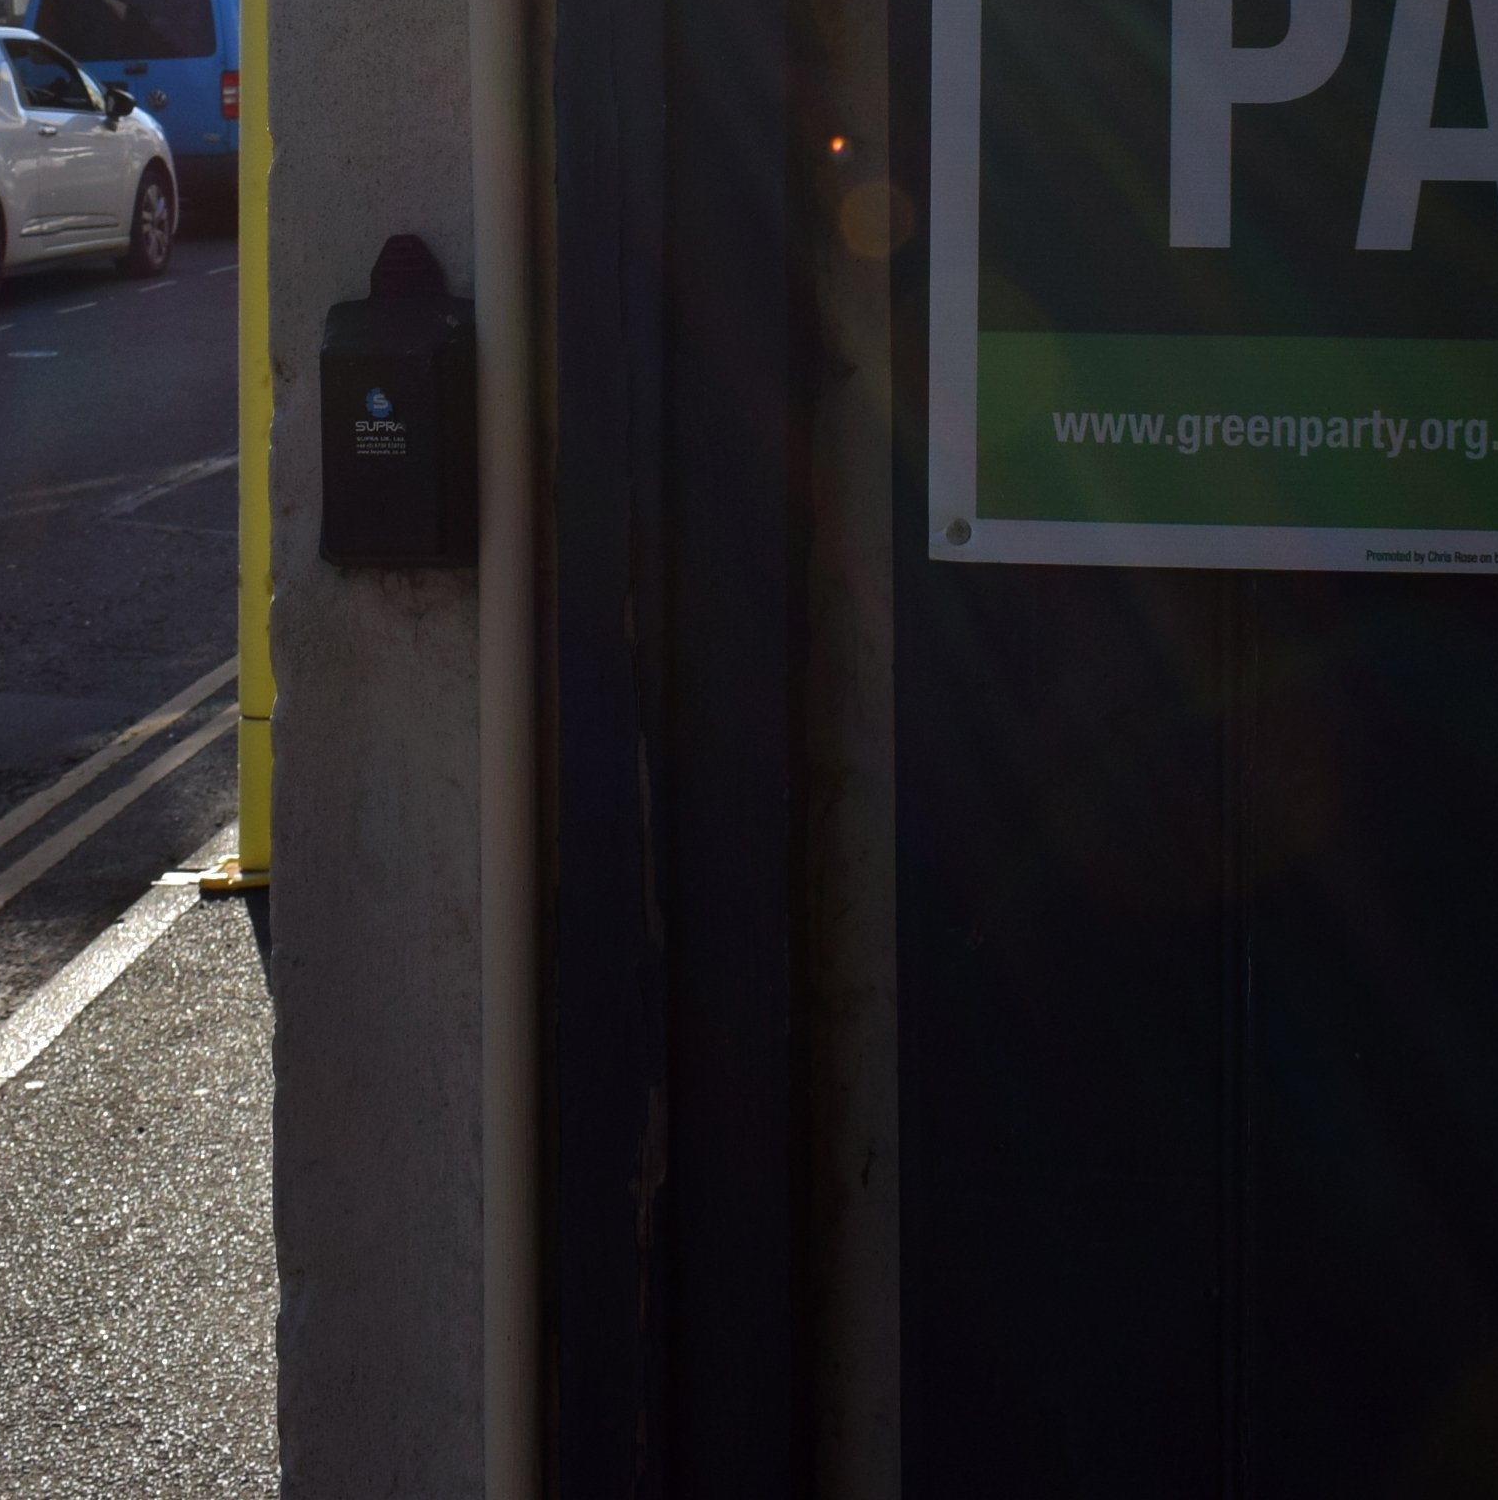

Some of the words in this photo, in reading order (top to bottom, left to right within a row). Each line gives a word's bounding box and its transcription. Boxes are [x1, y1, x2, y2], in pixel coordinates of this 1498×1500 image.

[355, 421, 405, 432] SUPRA
[1366, 550, 1411, 561] Promoted
[1414, 550, 1425, 564] by
[1428, 550, 1452, 563] Chris
[1454, 551, 1478, 563] Rose
[1479, 554, 1492, 564] on
